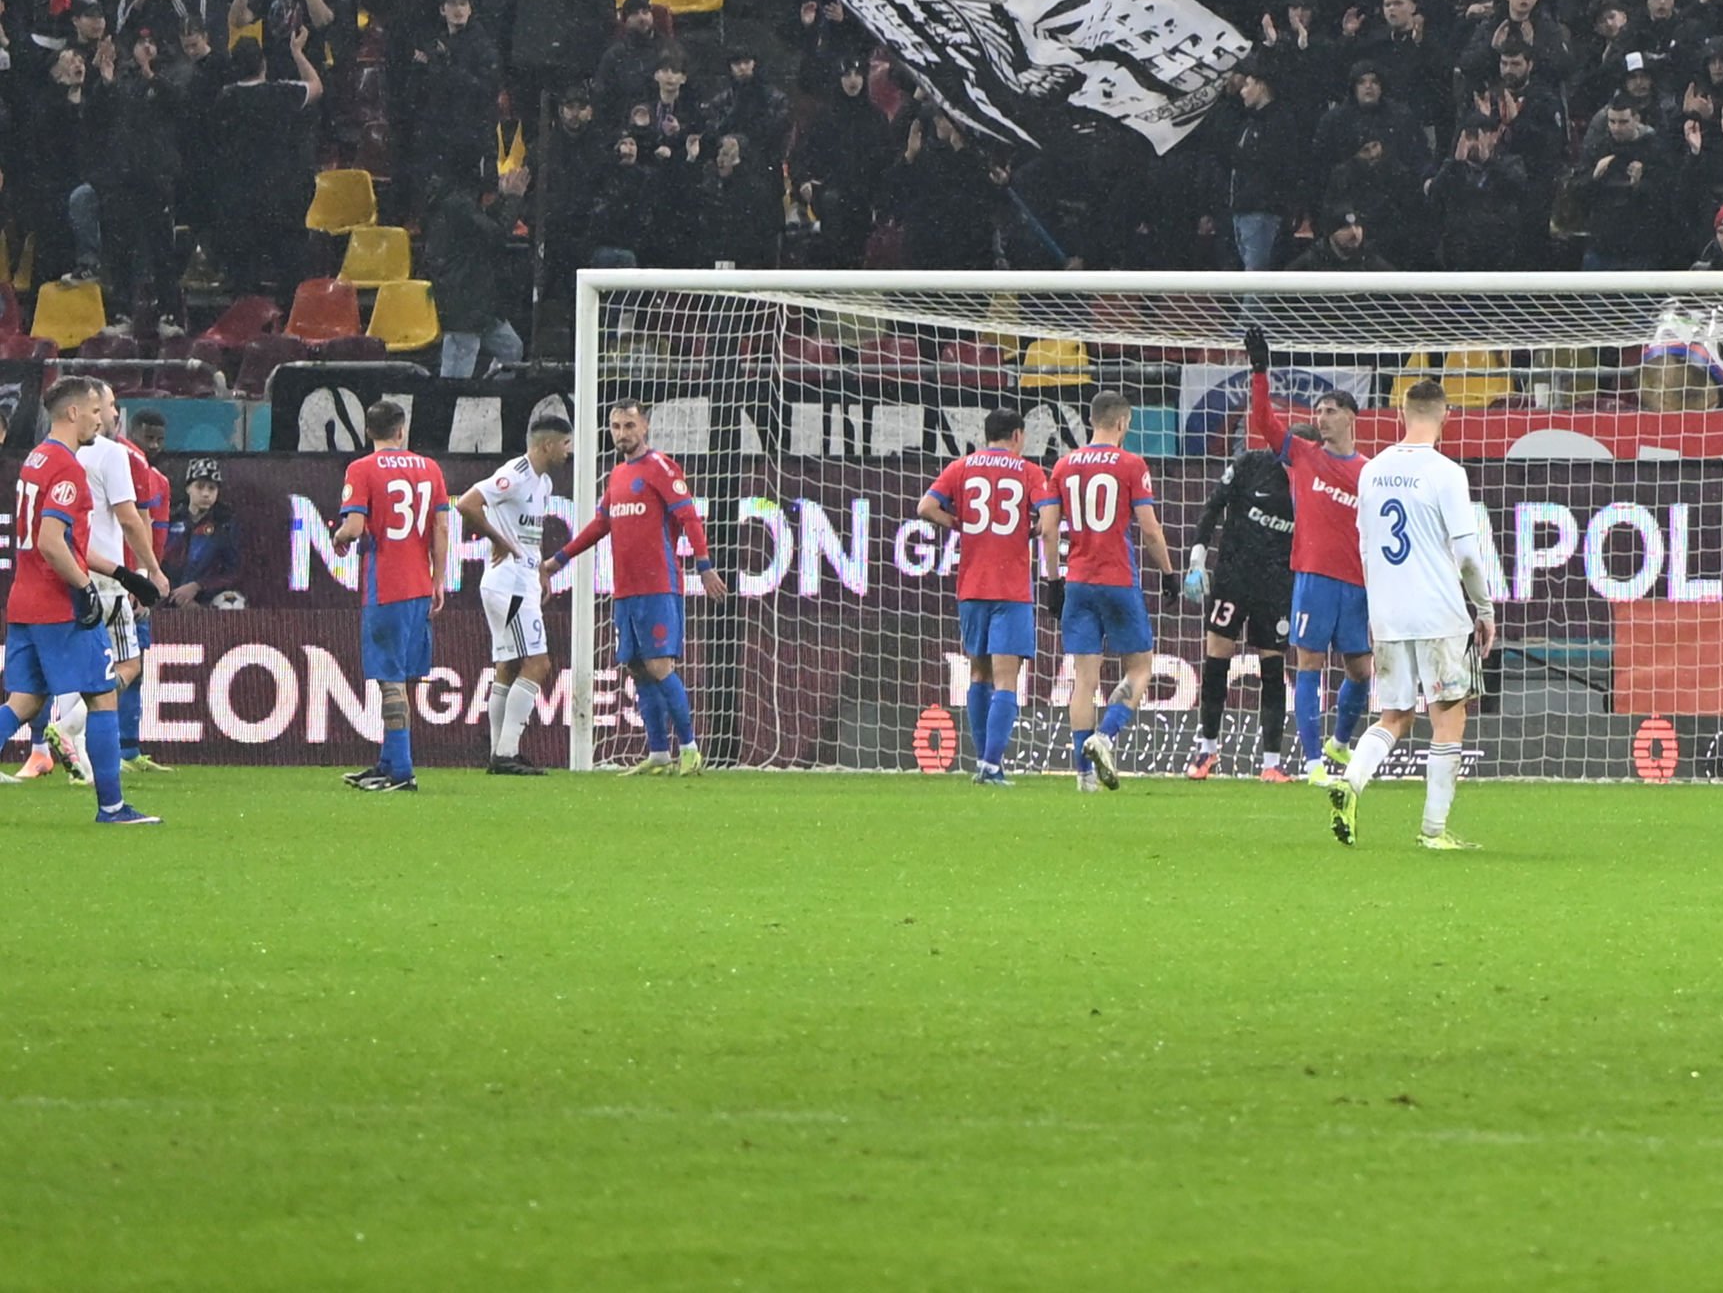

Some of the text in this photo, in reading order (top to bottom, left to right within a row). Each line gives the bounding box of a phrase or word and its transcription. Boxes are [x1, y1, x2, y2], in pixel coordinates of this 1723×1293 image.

[376, 455, 426, 470] CISOTTI
[964, 455, 1026, 472] RADUNOVIC
[1067, 451, 1121, 466] TANASE
[1311, 475, 1360, 510] Betan
[1371, 475, 1421, 489] PAVLOVIC
[385, 478, 432, 541] 31
[961, 476, 1024, 536] 33
[1064, 472, 1119, 533] 10
[1247, 505, 1295, 534] Betan
[1379, 497, 1412, 566] 3
[1209, 598, 1236, 627] 13
